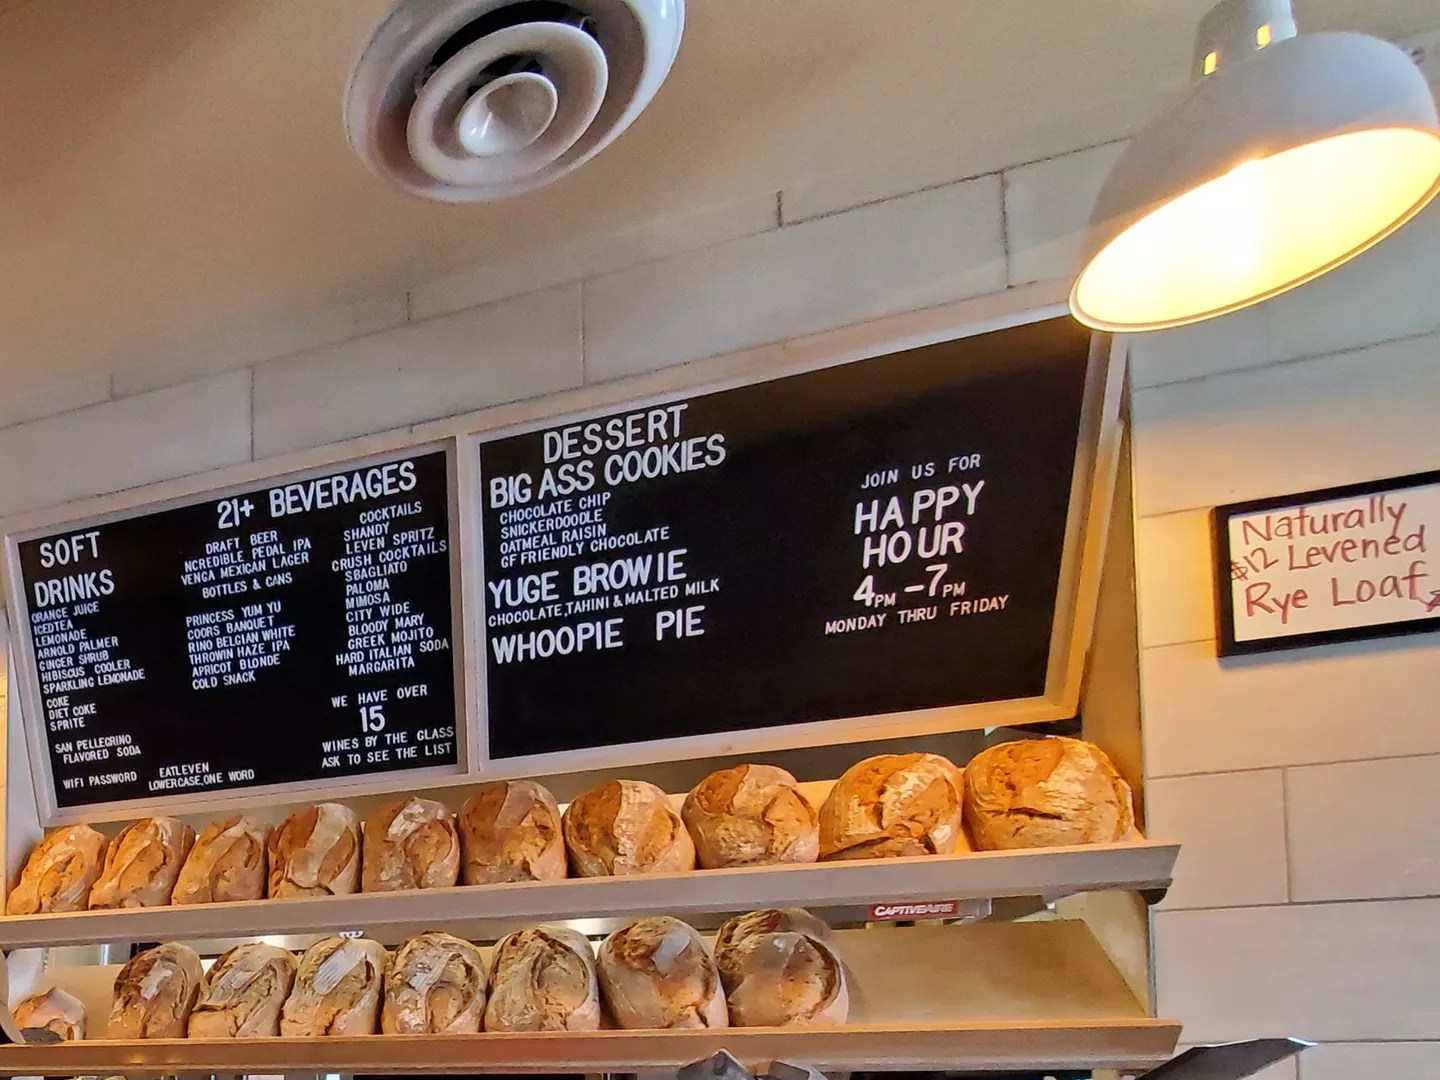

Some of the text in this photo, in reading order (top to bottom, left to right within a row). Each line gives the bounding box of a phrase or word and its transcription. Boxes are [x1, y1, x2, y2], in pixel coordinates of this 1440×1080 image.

[544, 404, 688, 464] DESSERT
[490, 434, 726, 509] BIG ASS COOKIES
[861, 454, 980, 489] JOIN US FOR
[218, 461, 417, 529] 21+ BEVERAGES
[854, 480, 985, 534] HAPPY
[360, 502, 422, 524] COCKTAILS
[500, 492, 611, 525] CHOCOLATE CHIP
[1242, 495, 1407, 545] Naturally
[344, 522, 390, 542] SHANDY
[501, 509, 602, 540] SNICKERDOODLE
[40, 532, 100, 568] SOFT
[206, 530, 278, 554] DRAFT BEER
[346, 527, 435, 554] LEVEN SPRITZ
[500, 524, 607, 554] OATMEAL RAISIN
[501, 527, 670, 569] GF FRIENDLY CHOCOLATE
[863, 522, 964, 569] HOUR
[1288, 525, 1426, 570] Levened
[185, 538, 311, 573] NCREDIBLE PEDAL IPA
[332, 540, 447, 572] CRUSH COCKTAILS
[181, 552, 309, 586] VENGA MEXICAN LAGER
[345, 561, 407, 582] SBAGLIATO
[488, 549, 688, 609] YUGE BROWIE
[34, 569, 114, 607] DRINKS
[202, 572, 292, 599] BOTTLES & CANS
[346, 578, 390, 596] PALOMA
[614, 595, 623, 607] &
[625, 585, 678, 605] MALTED
[685, 579, 720, 597] MILK
[1245, 561, 1428, 624] Rye Loaf
[32, 601, 100, 623] ORANGE JUICE
[346, 591, 390, 609] MIMOSA
[346, 602, 410, 623] CITY WIDE
[186, 601, 281, 627] PRINCESS YUM YU
[348, 613, 424, 636] BLOODY MARY
[825, 595, 1009, 634] MONDAY THRU FRIDAY
[35, 629, 87, 647] LEMONADE
[188, 616, 274, 640] COORS BANQUET
[188, 625, 296, 653] RINO BELGIAN WHITE
[348, 627, 434, 650] GREEK MOJITO
[492, 605, 706, 664] WHOOPIE PIE
[38, 636, 119, 659] ARNOLD PALMER
[189, 640, 290, 665] THROWIN HAZE IPA
[336, 638, 449, 666] HARD ITALIAN SODA
[39, 650, 109, 671] GINGER SHRUB
[42, 659, 131, 682] HIBISCUS COOLER
[192, 654, 280, 677] APRICOT BLONDE
[349, 657, 415, 676] MARGARITA
[43, 669, 145, 694] SPARKLING LEMONADE
[193, 670, 256, 690] COLD SNACK
[46, 696, 70, 709] COKE
[331, 685, 427, 708] WE HAVE OVER
[49, 703, 97, 720] DIET COKE
[50, 717, 85, 731] SPRITE
[360, 705, 385, 732] 15
[55, 735, 131, 754] SAN PELLEGRINO
[322, 727, 454, 752] WINES BY THE GLASS
[63, 745, 141, 764] FLAVORED SODA
[322, 742, 452, 768] ASK TO SEE THE LIST
[63, 771, 137, 790] WIFI PASSWORD
[159, 762, 210, 778] EATLEVEN
[228, 769, 255, 781] WORD
